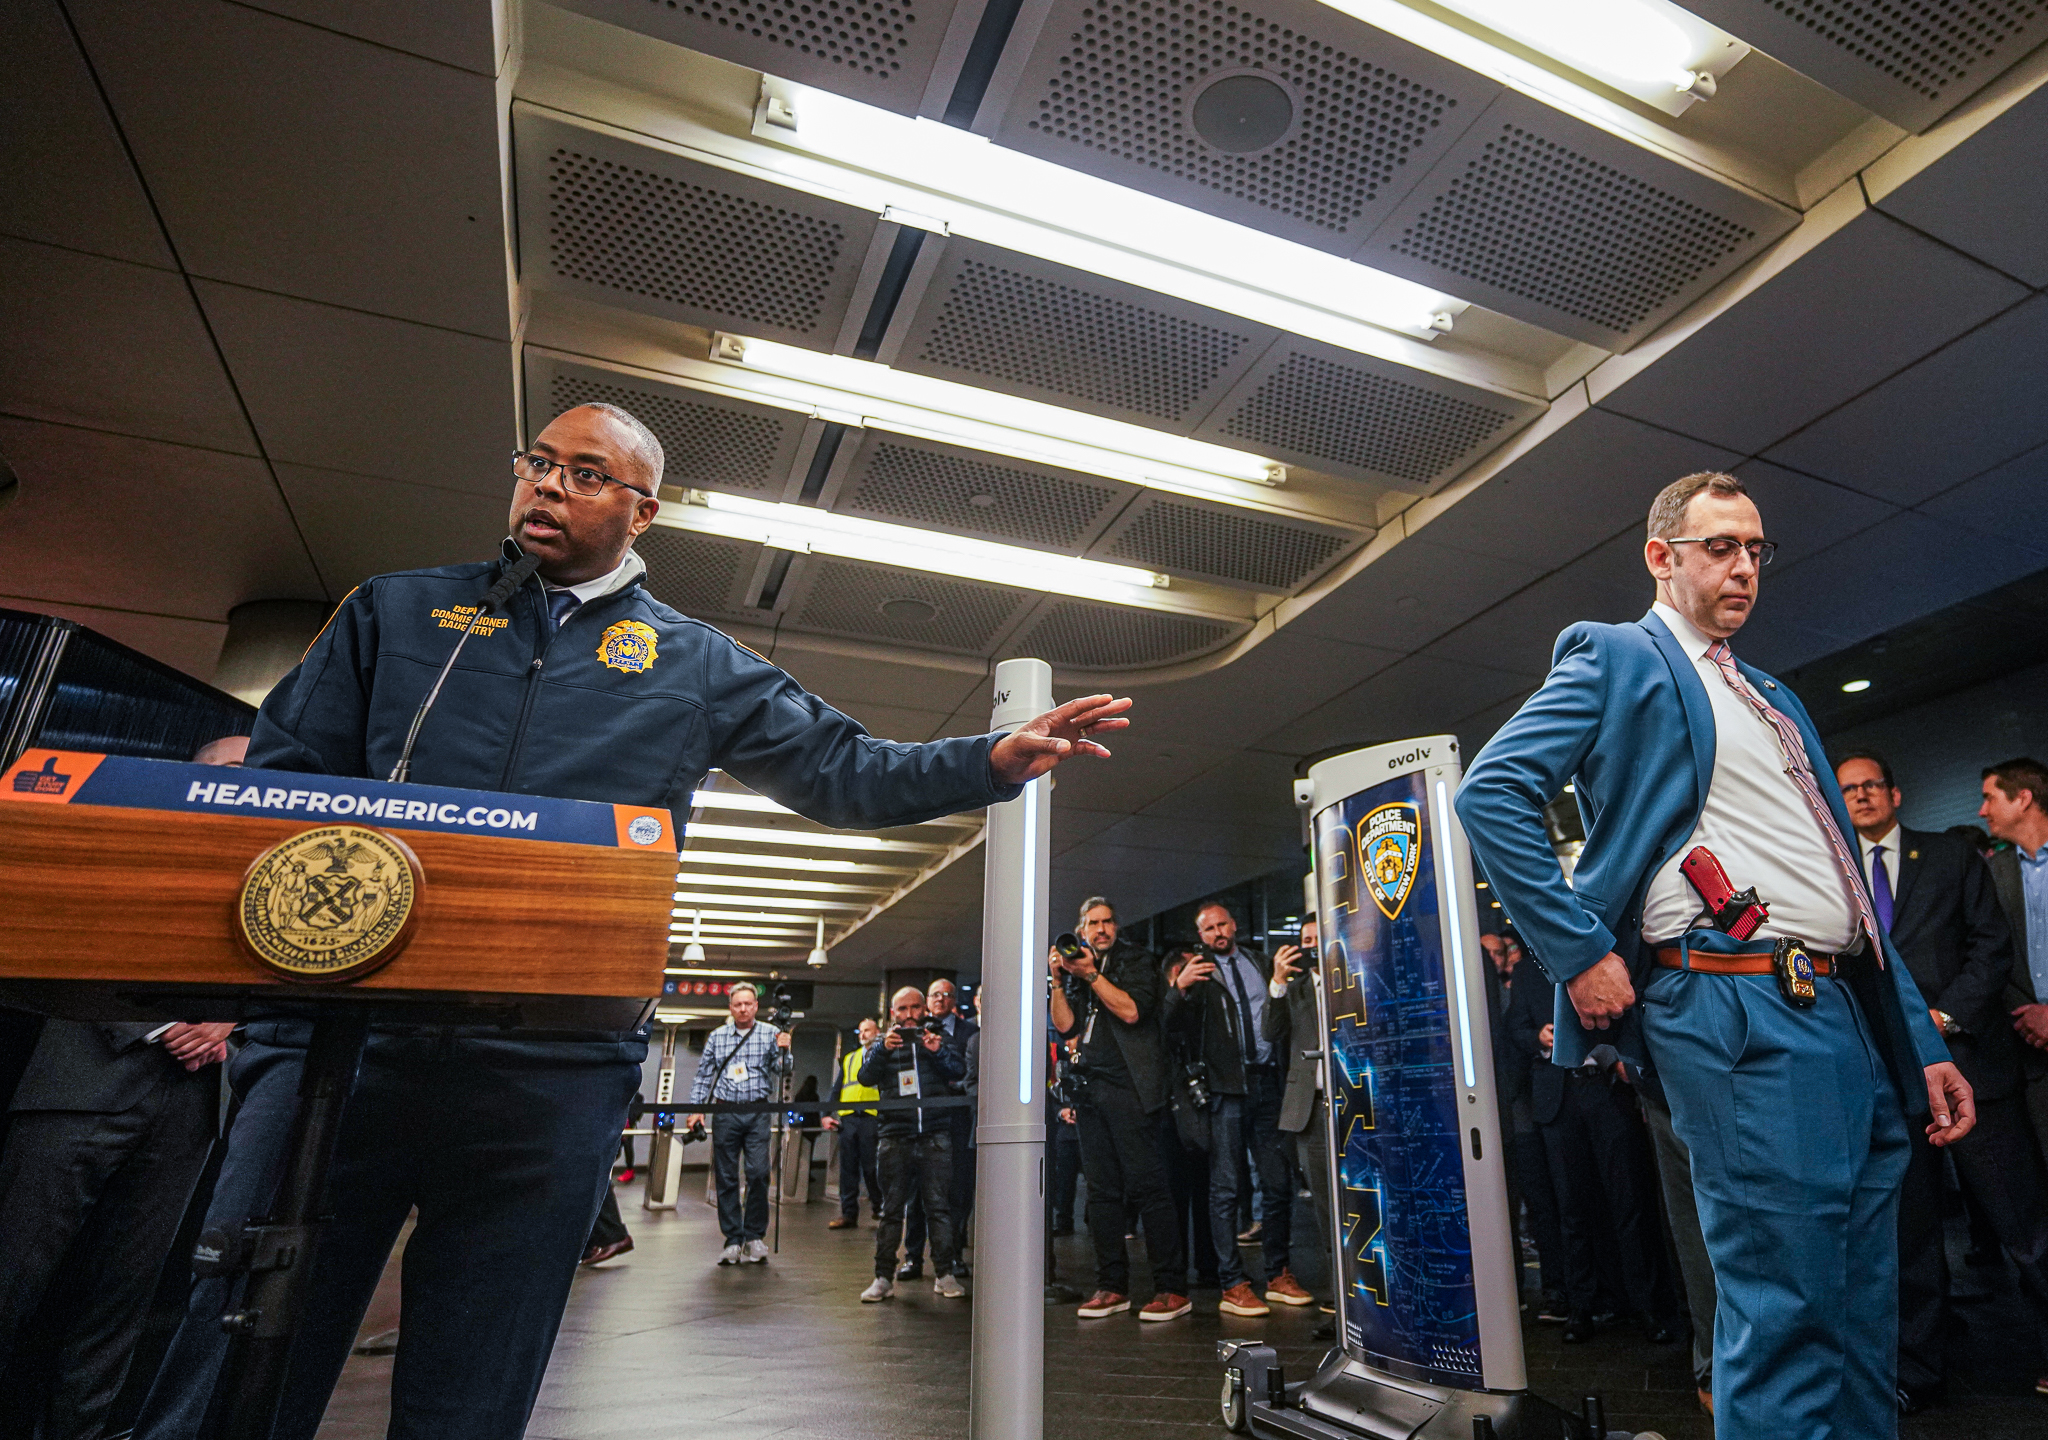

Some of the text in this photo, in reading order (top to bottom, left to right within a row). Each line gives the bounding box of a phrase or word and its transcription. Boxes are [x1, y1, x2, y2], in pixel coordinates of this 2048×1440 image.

[453, 605, 478, 615] DEP
[1388, 747, 1431, 769] evolv
[186, 781, 539, 831] HEARFROMERIC.COM
[1369, 808, 1402, 830] POLICE
[1361, 820, 1416, 851] DEPARTMENT
[1364, 860, 1386, 901] CITY OF
[1395, 873, 1411, 901] NEW
[1405, 842, 1417, 873] YORK
